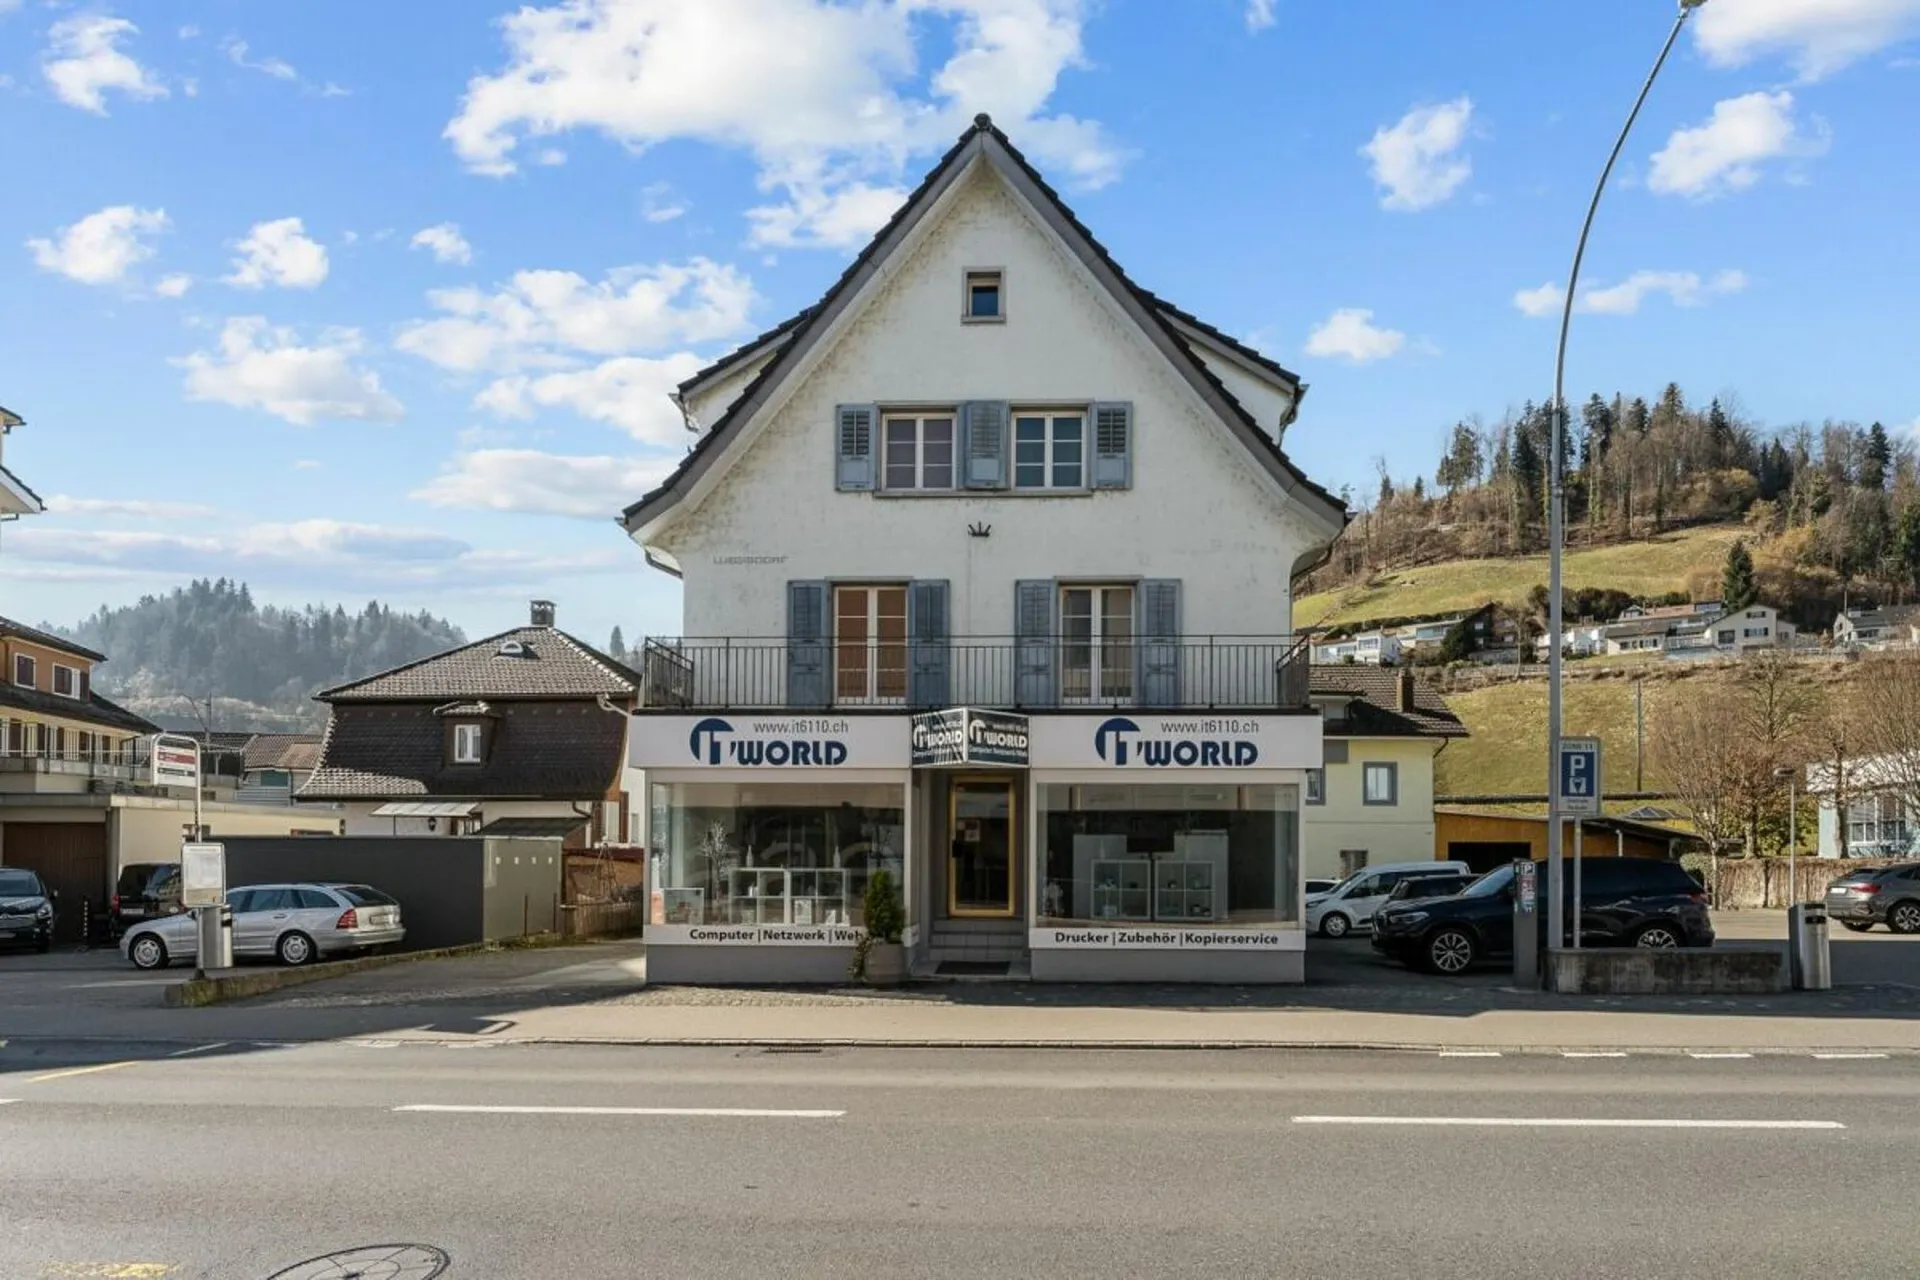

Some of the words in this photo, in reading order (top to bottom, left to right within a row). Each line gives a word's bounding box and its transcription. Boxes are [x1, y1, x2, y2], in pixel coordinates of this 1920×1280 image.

[753, 719, 848, 733] www.it6110.ch
[1161, 719, 1259, 733] www.it6110.ch
[1570, 754, 1586, 777] P
[689, 928, 754, 942] Computer
[763, 929, 825, 941] Netzwerk
[1055, 931, 1109, 943] Drucker
[1118, 931, 1176, 943] Zubehör
[1185, 932, 1278, 945] Kopierservice
